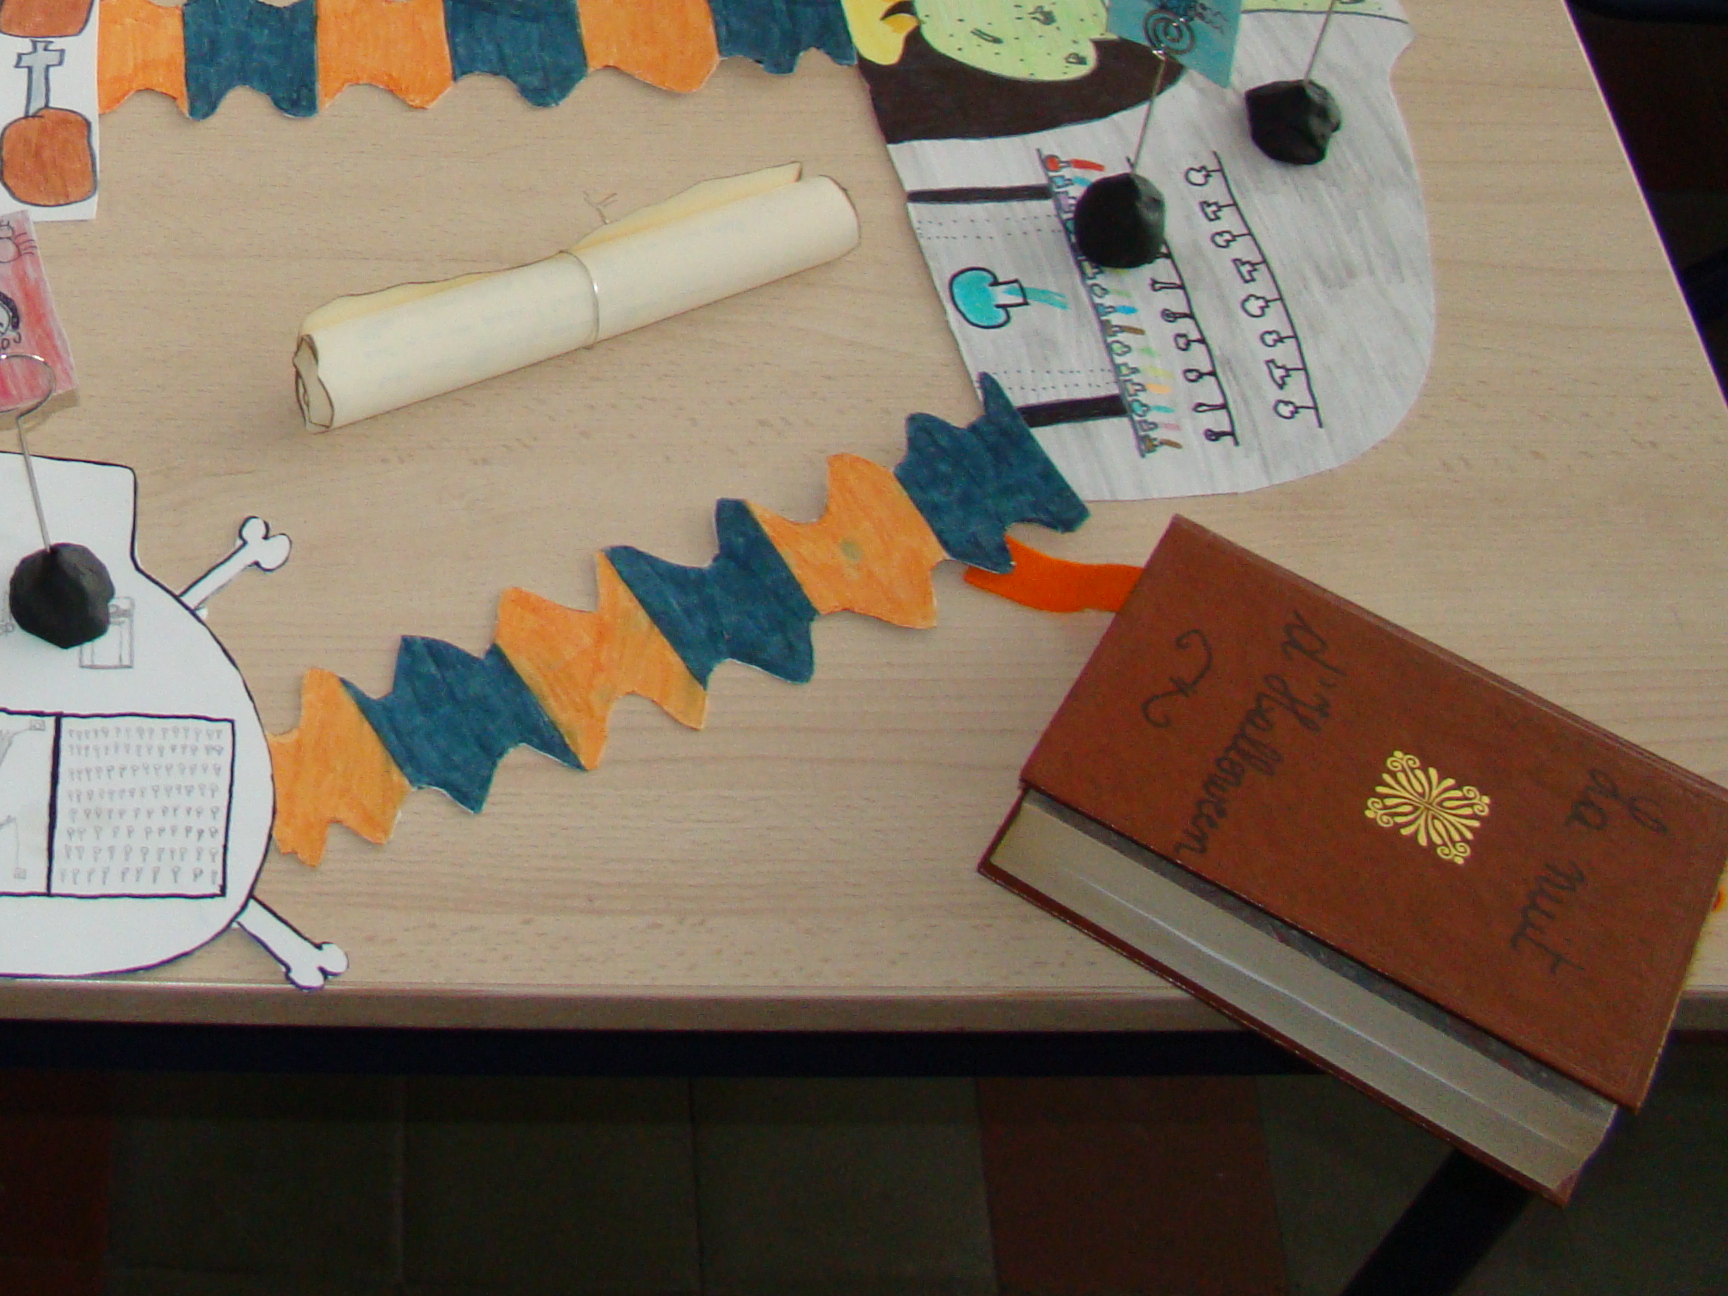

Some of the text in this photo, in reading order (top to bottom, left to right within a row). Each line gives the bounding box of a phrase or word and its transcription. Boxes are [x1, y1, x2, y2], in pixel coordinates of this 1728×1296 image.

[1173, 609, 1349, 860] d'Halloween
[1510, 767, 1669, 976] La nuit
